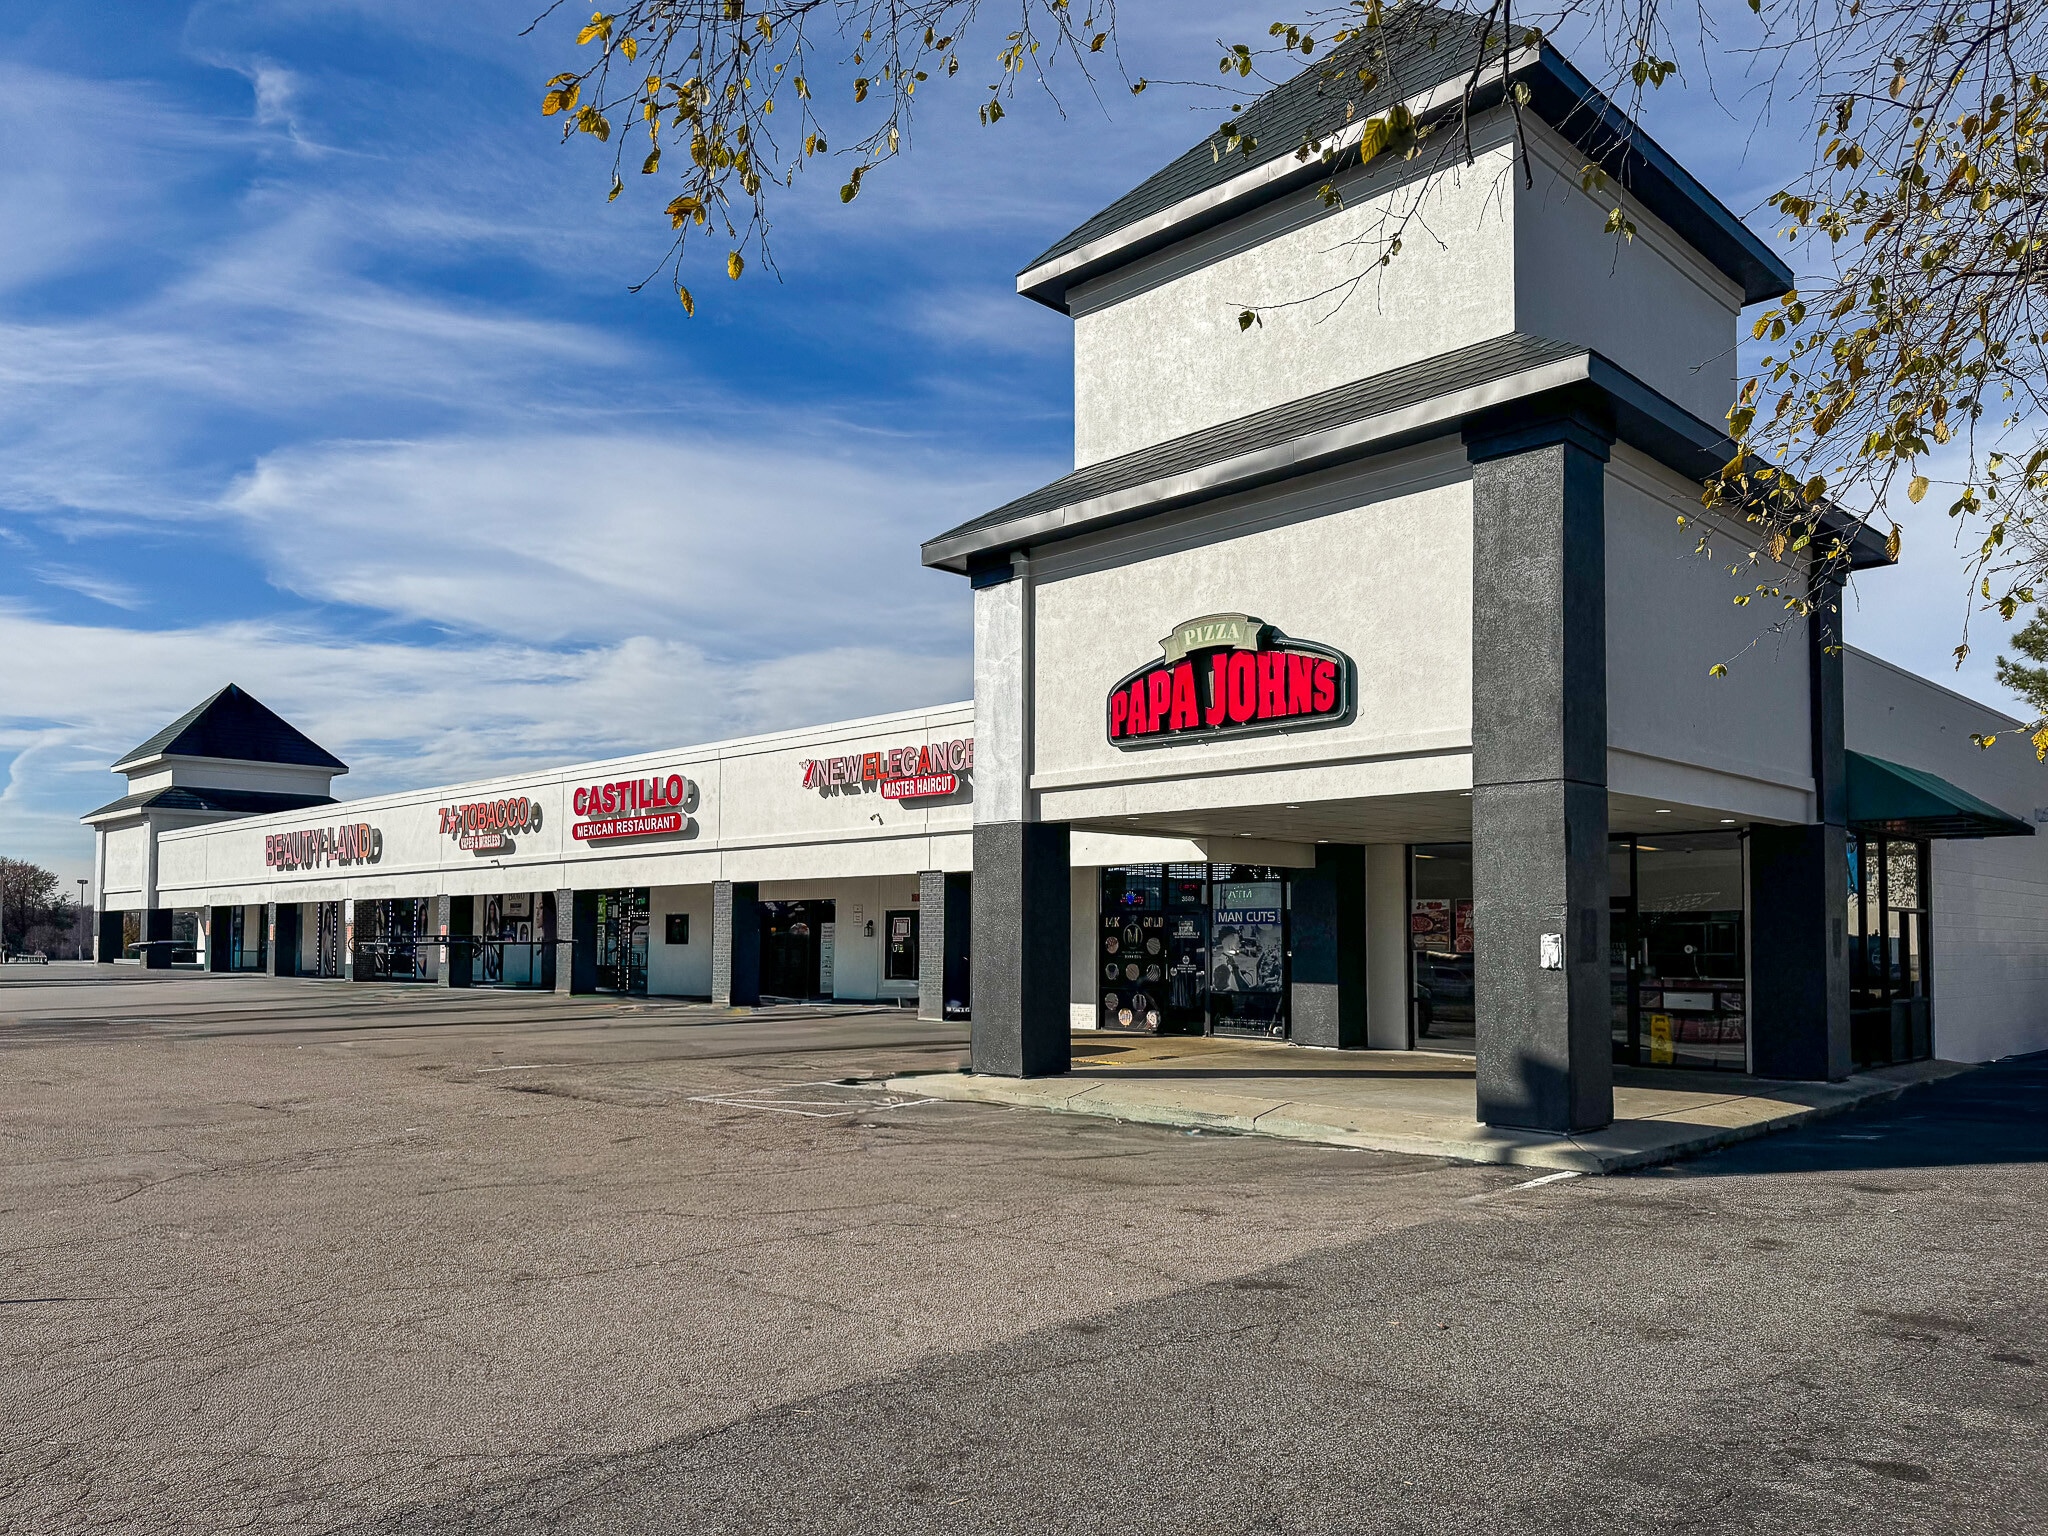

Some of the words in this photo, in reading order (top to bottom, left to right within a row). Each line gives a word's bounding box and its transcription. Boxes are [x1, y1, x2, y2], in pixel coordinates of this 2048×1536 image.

[1184, 622, 1239, 646] PIZZA
[1110, 660, 1199, 737] PAPA
[1205, 650, 1335, 726] JOHN'S
[816, 754, 861, 787] NEW
[862, 738, 974, 780] ELEGANCE
[573, 774, 684, 816] CASTILLO
[883, 780, 914, 798] MASTER
[916, 775, 953, 794] HAIRCUT
[459, 797, 528, 831] TOBACCO
[577, 822, 614, 837] MEXICAN
[616, 815, 675, 833] RESTAURANT
[265, 829, 323, 867] BEAUTY
[327, 823, 371, 861] LAND
[1105, 917, 1121, 928] 14K
[1143, 916, 1164, 928] GOLD
[1218, 911, 1243, 923] MAN
[1246, 911, 1276, 922] CUTS
